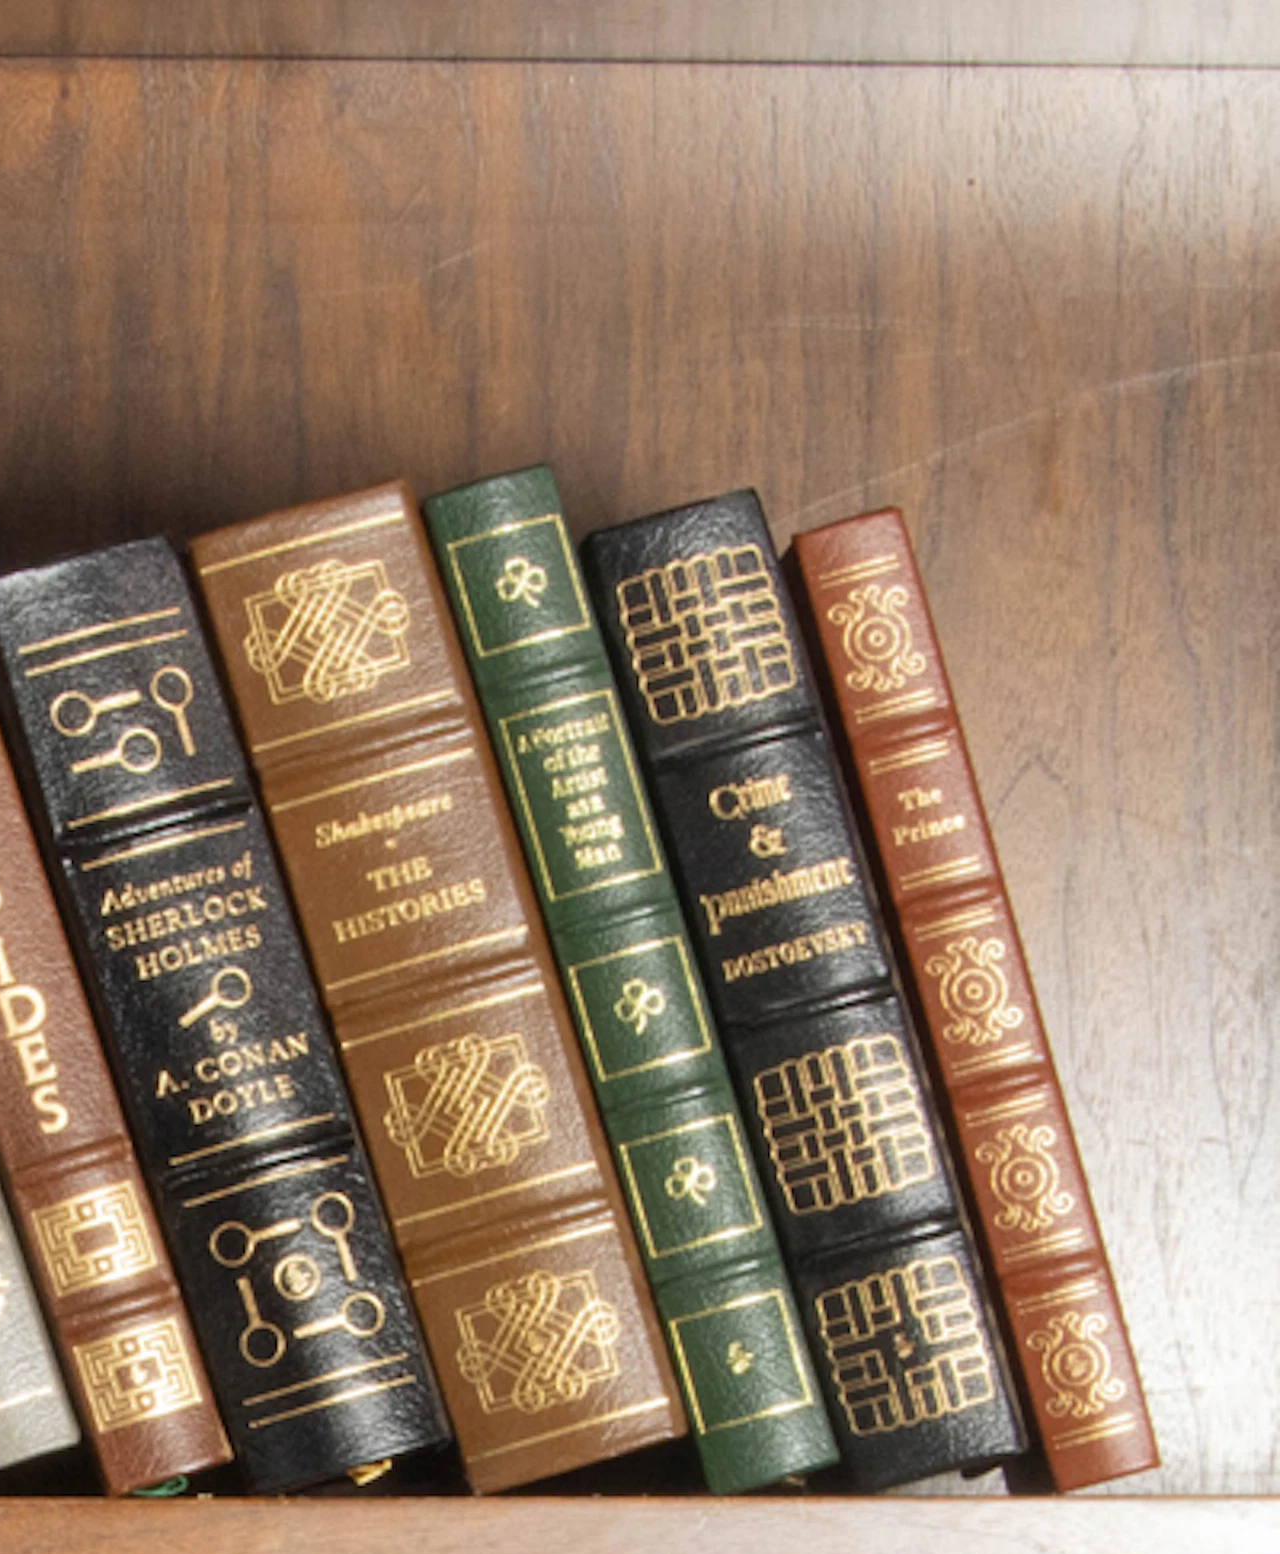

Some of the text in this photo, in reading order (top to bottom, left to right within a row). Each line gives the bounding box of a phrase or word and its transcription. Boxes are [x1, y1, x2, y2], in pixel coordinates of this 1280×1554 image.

[708, 774, 793, 820] Crime
[897, 786, 943, 811] The
[749, 825, 787, 858] &
[893, 814, 966, 846] Prince
[100, 850, 254, 917] Adventures of
[367, 855, 433, 893] THE
[104, 887, 268, 952] SHERLOCK
[332, 878, 489, 944] HISTORIES
[135, 924, 262, 980] HOLMES
[722, 920, 867, 982] DOSTOEVSKY
[208, 1018, 239, 1046] by
[155, 1032, 310, 1098] A. CONAN
[187, 1074, 296, 1126] DOYLE
